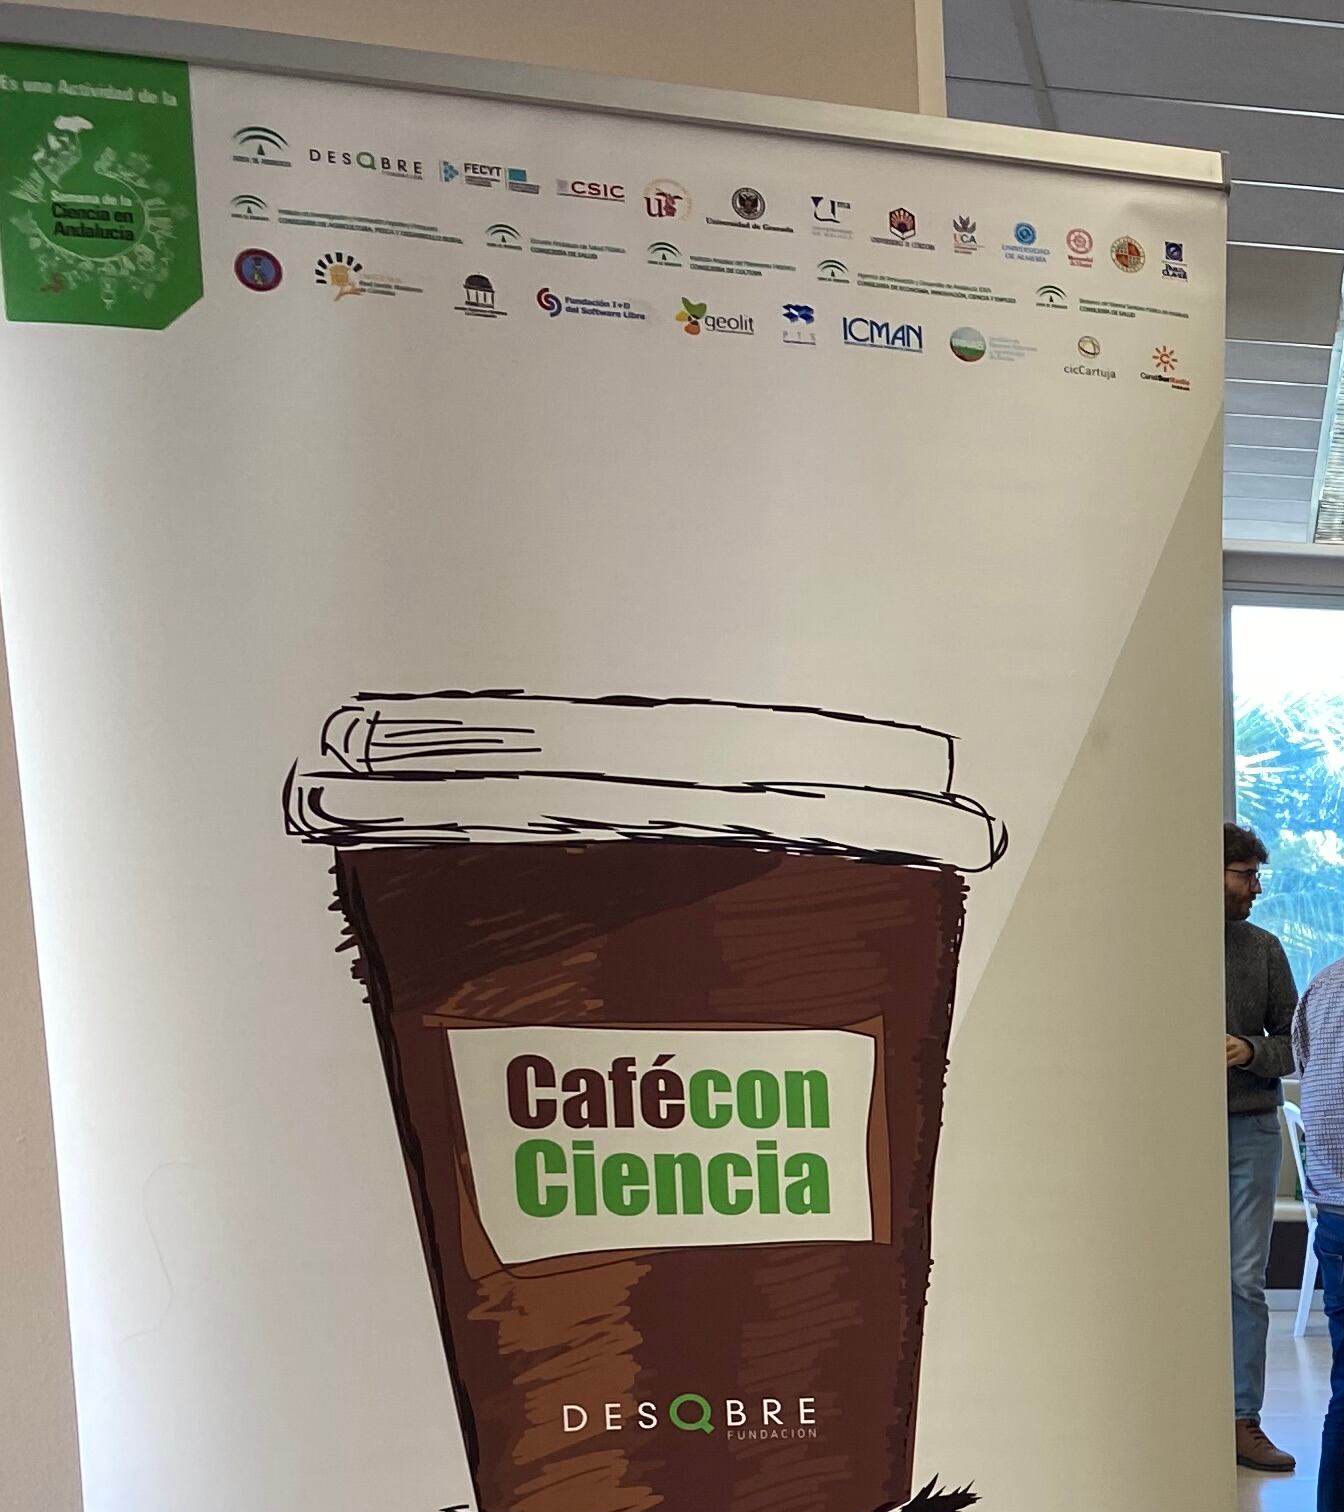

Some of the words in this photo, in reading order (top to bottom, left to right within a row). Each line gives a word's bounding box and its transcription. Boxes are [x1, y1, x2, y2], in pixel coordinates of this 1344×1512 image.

[463, 163, 502, 177] FECYT
[571, 181, 625, 199] CSIC
[52, 203, 110, 221] Ciencia
[114, 208, 134, 223] en
[704, 314, 755, 332] geolit
[843, 316, 923, 349] ICMAN
[1063, 364, 1117, 381] cicCartuja
[514, 1138, 831, 1218] Ciencia
